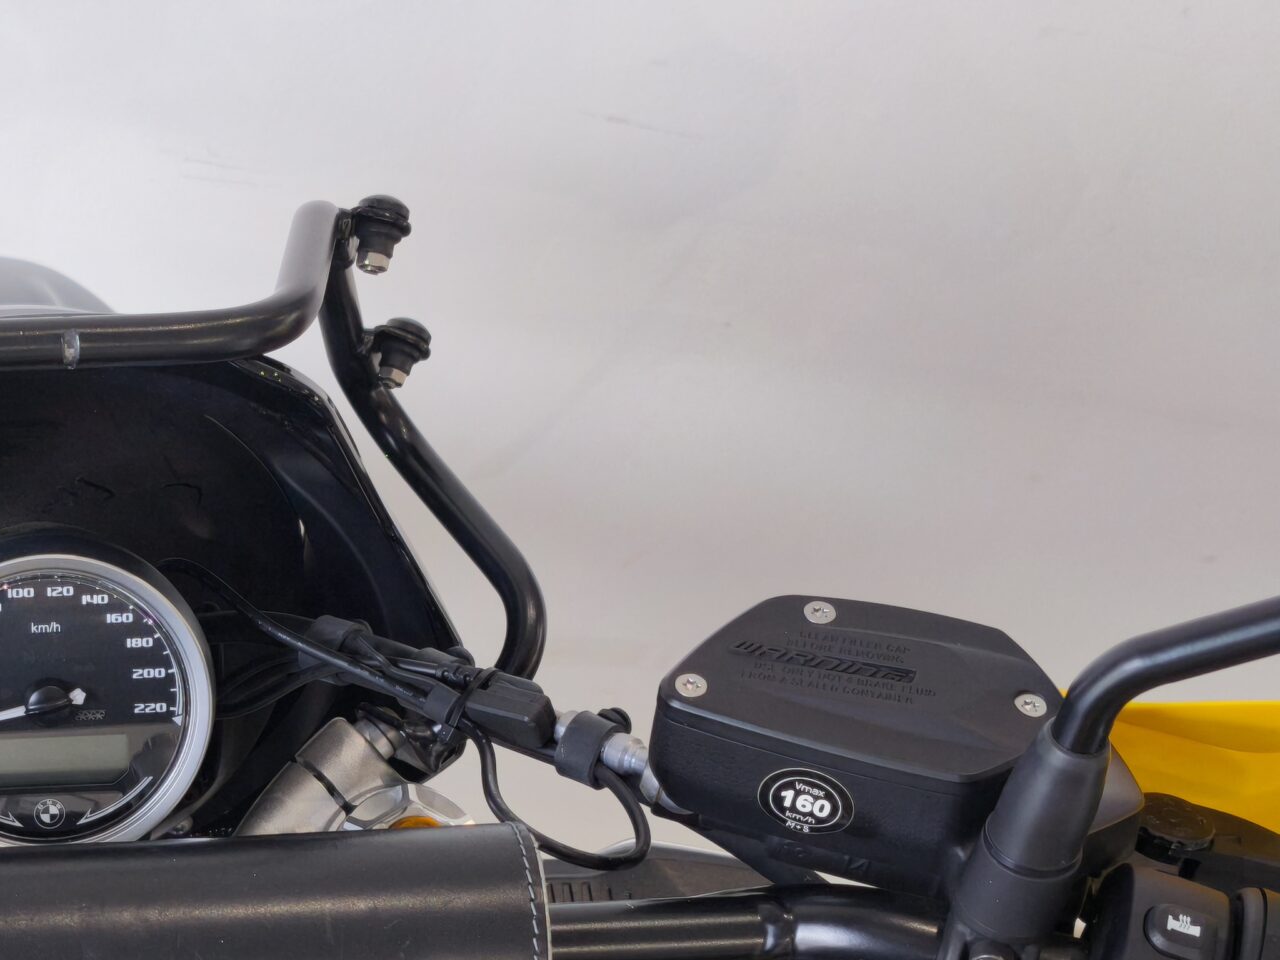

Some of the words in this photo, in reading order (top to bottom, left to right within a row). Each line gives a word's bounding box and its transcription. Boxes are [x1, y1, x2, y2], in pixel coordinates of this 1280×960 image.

[7, 587, 35, 598] 100
[46, 586, 74, 597] 120
[81, 594, 109, 605] 140
[106, 613, 133, 623] 160
[30, 622, 61, 633] km/h
[126, 637, 153, 648] 180
[132, 668, 166, 679] 200
[134, 702, 167, 713] 220
[795, 781, 826, 798] Vmax
[780, 790, 831, 818] 160
[785, 809, 816, 825] km/h
